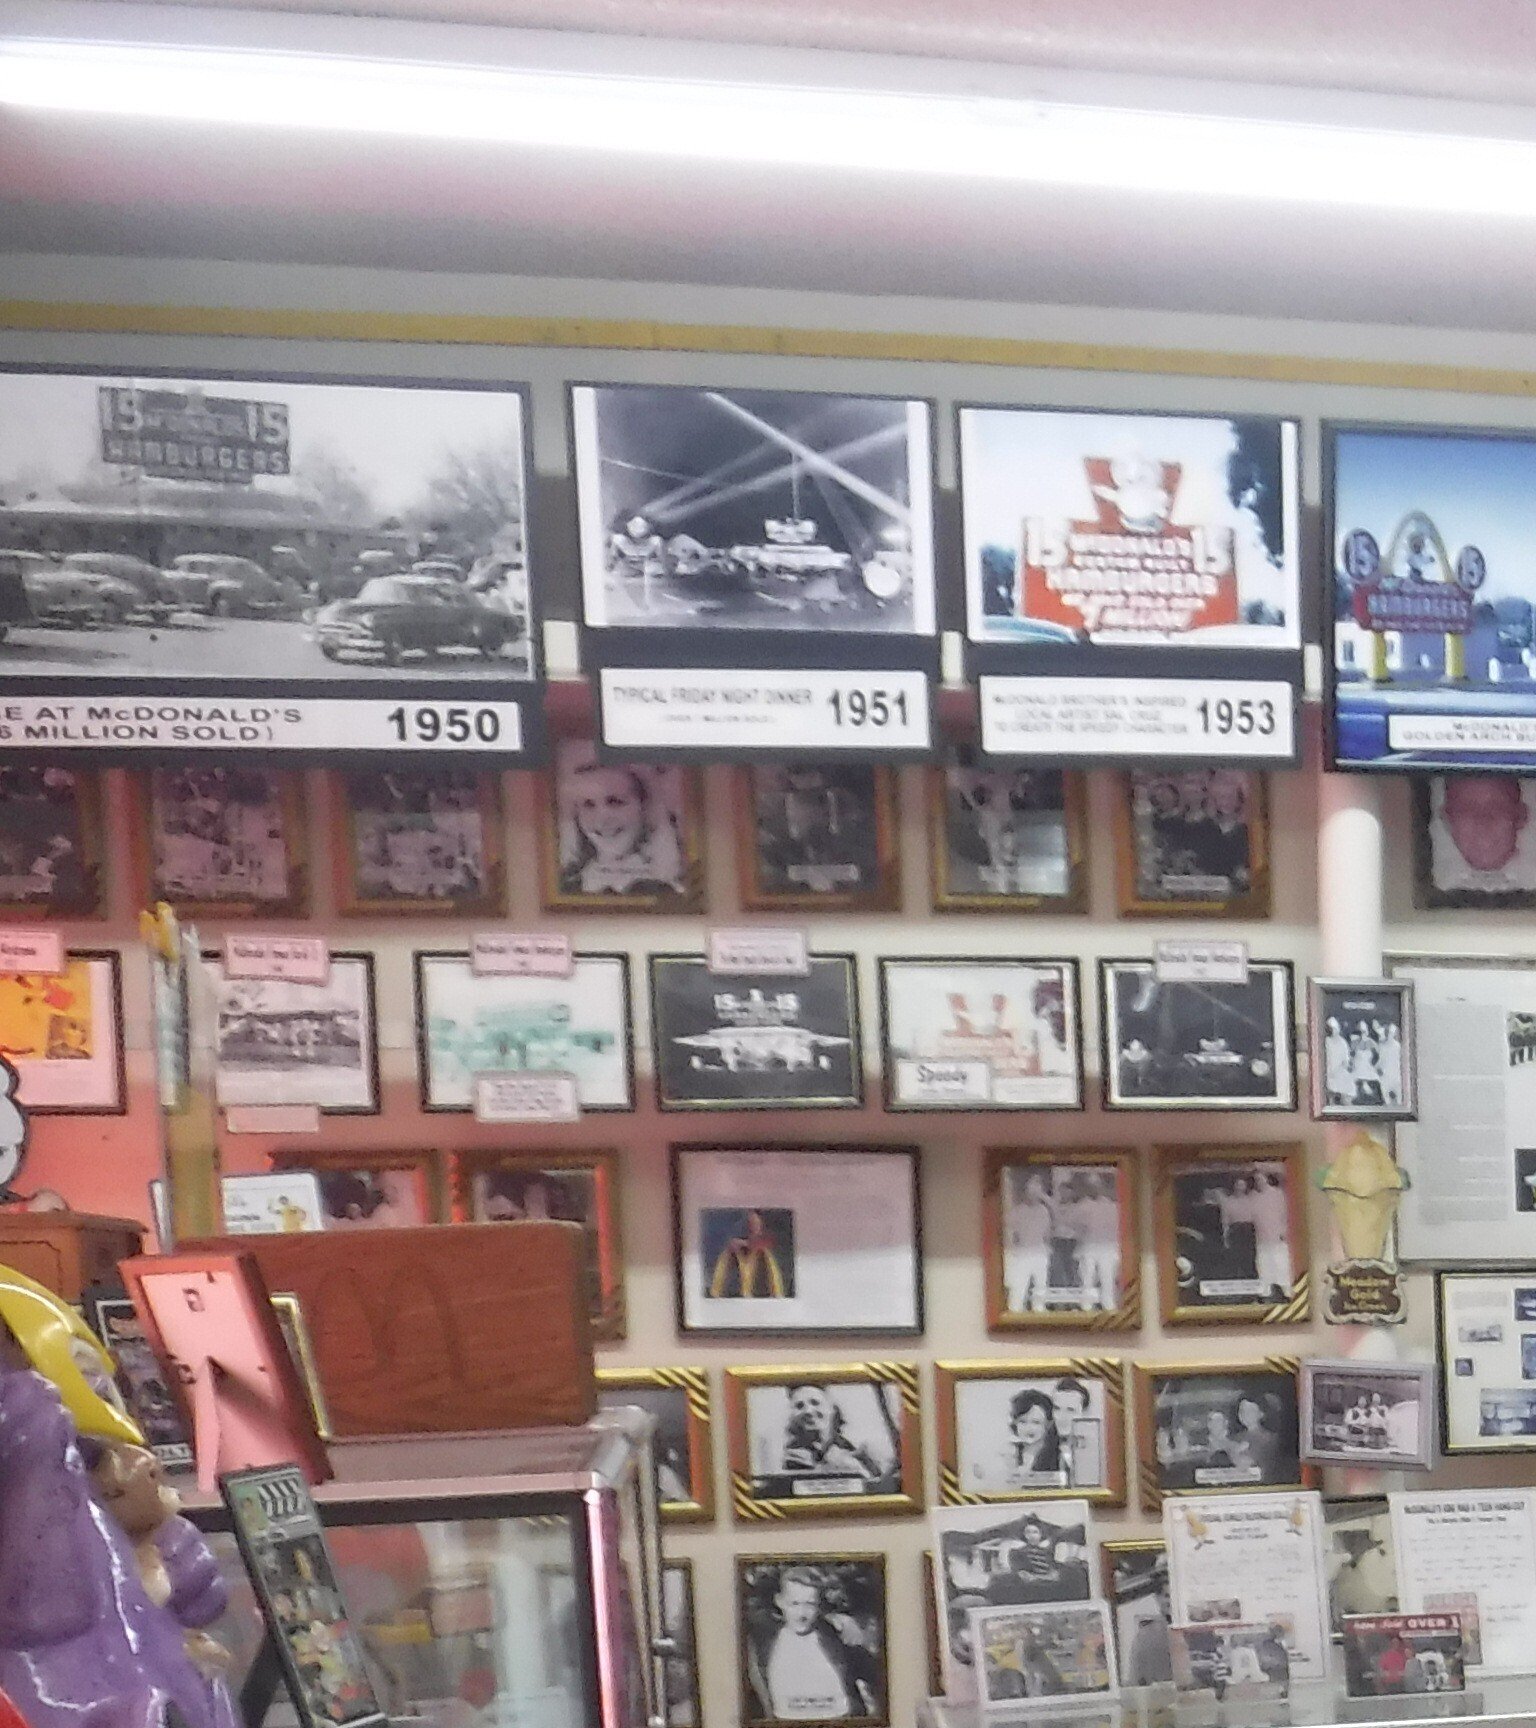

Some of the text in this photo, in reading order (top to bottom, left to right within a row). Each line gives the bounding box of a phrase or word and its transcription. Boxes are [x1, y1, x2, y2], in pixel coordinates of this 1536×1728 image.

[36, 706, 74, 721] AT
[87, 705, 303, 723] McDONALD'S
[387, 707, 501, 743] 1950
[828, 688, 909, 727] 1951
[1197, 698, 1276, 735] 1953
[24, 725, 158, 740] MILLION
